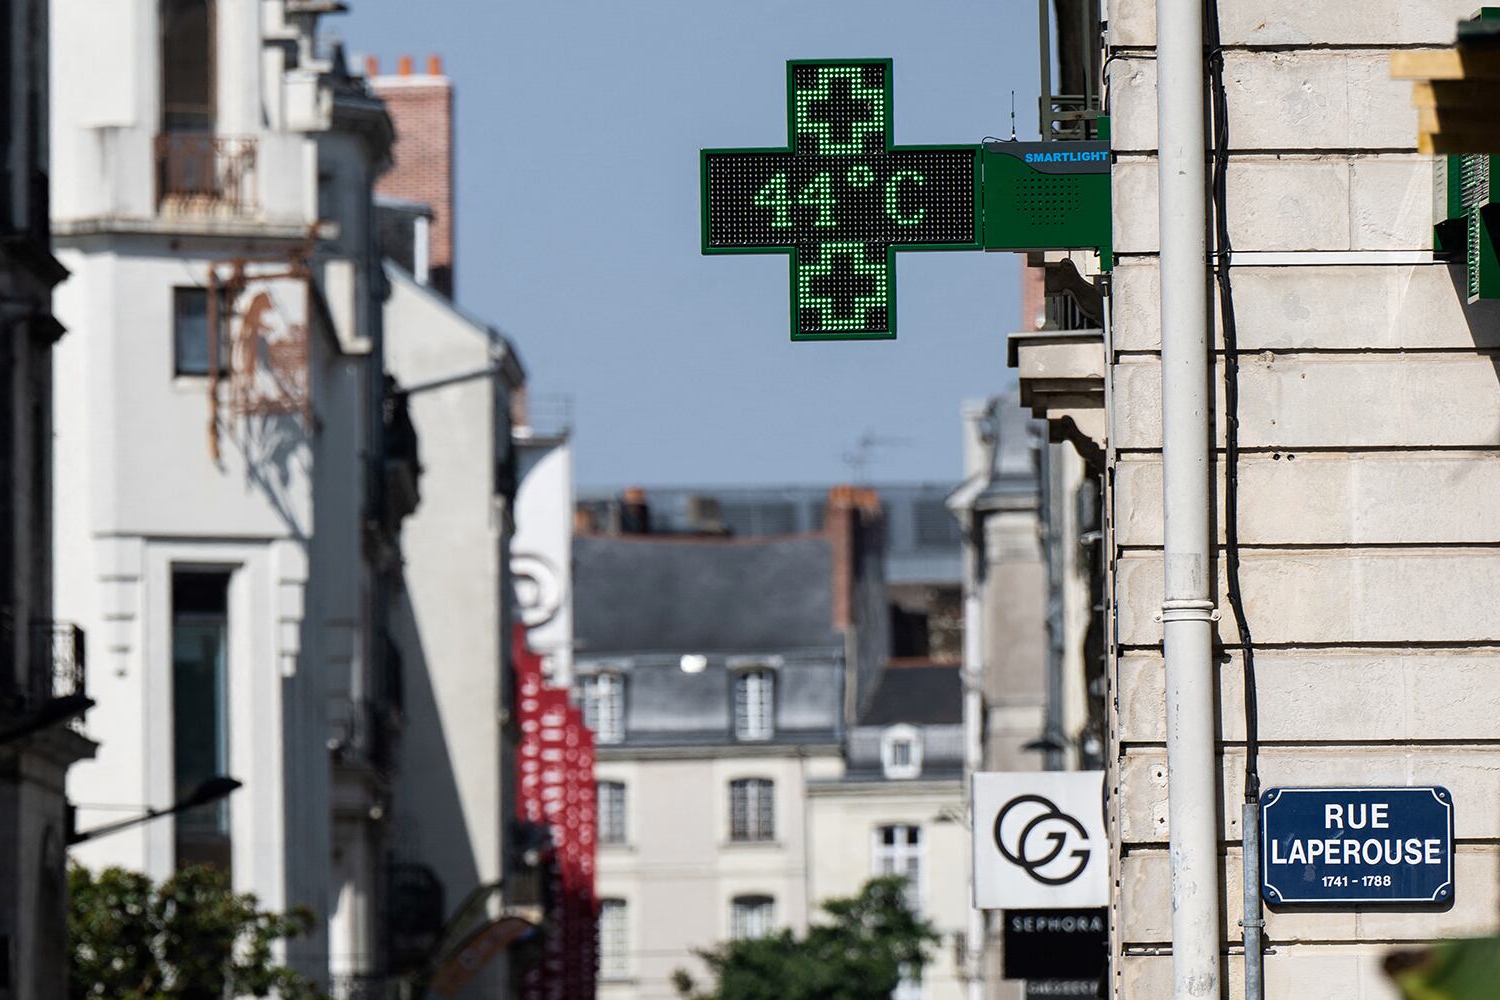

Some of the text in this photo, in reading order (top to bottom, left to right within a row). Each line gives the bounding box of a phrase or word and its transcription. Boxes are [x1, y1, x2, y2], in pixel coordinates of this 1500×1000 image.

[1024, 151, 1108, 164] SMARTLIGHT
[1324, 803, 1389, 829] RUE
[1271, 838, 1442, 865] LAPEROUSE
[1321, 875, 1348, 888] 1741
[1362, 874, 1392, 888] 1788
[1012, 916, 1102, 933] SEPHORA
